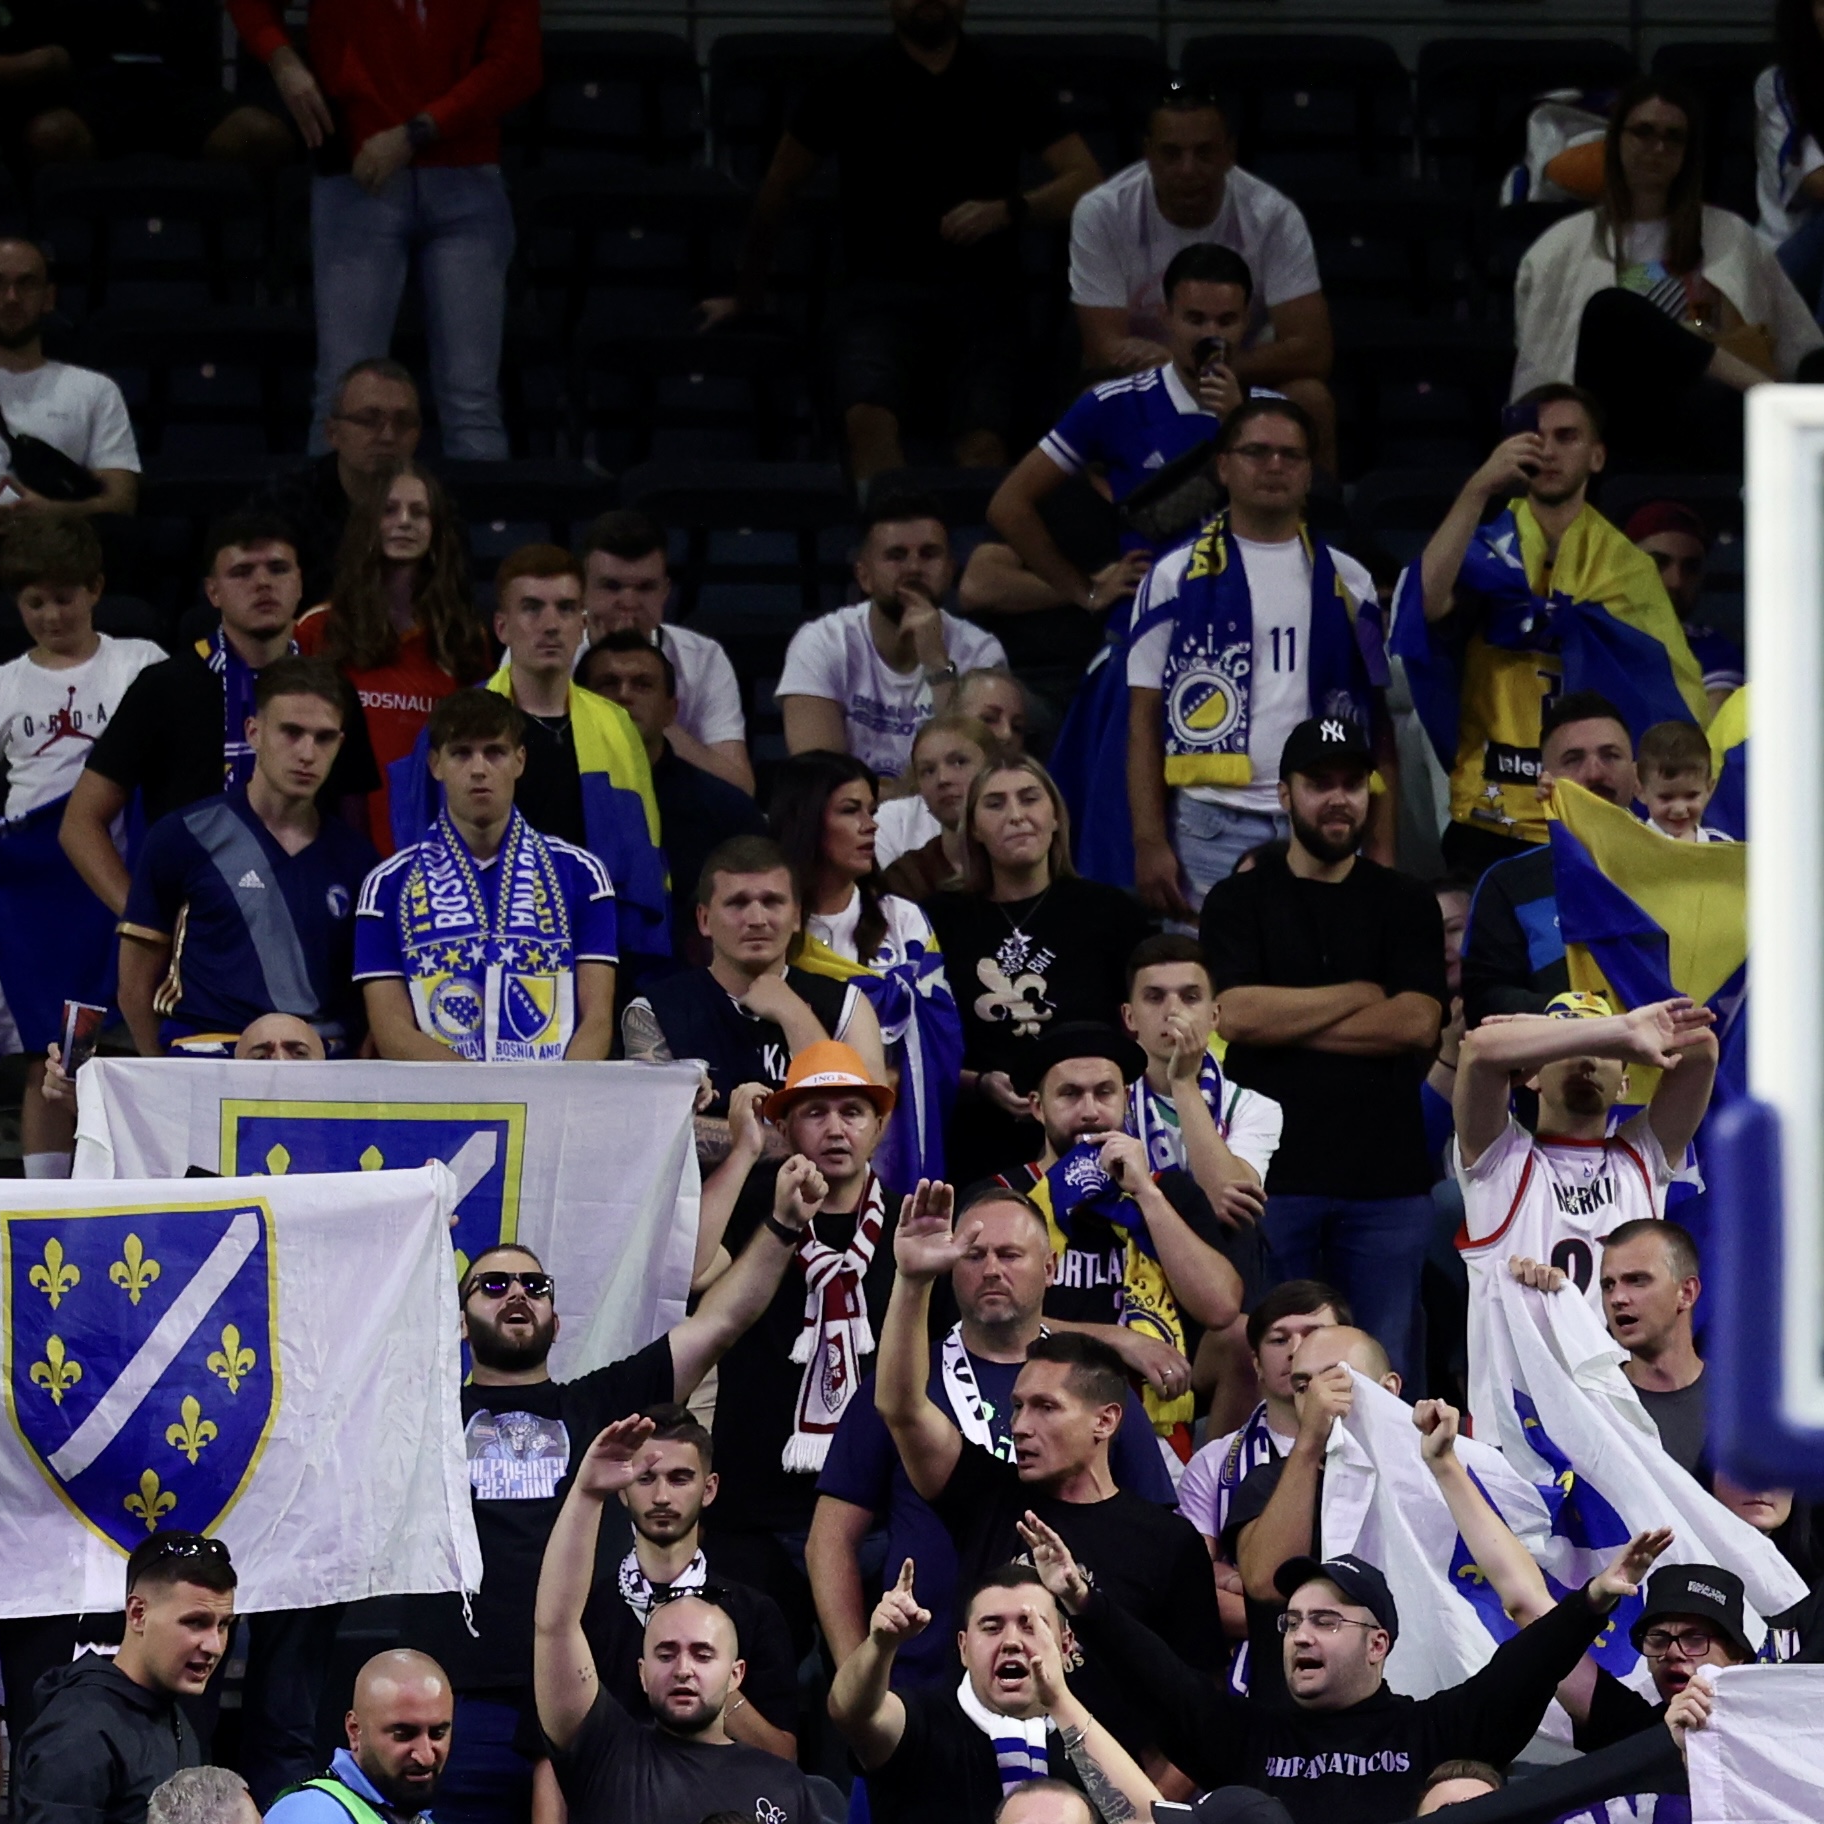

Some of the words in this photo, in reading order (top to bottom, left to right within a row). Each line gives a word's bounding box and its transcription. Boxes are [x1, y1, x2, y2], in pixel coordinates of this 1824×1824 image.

[1270, 626, 1296, 673] 11
[1320, 717, 1347, 744] NY
[495, 1040, 535, 1059] BOSNIA
[813, 1073, 836, 1085] ING
[1552, 1177, 1616, 1216] NURKI
